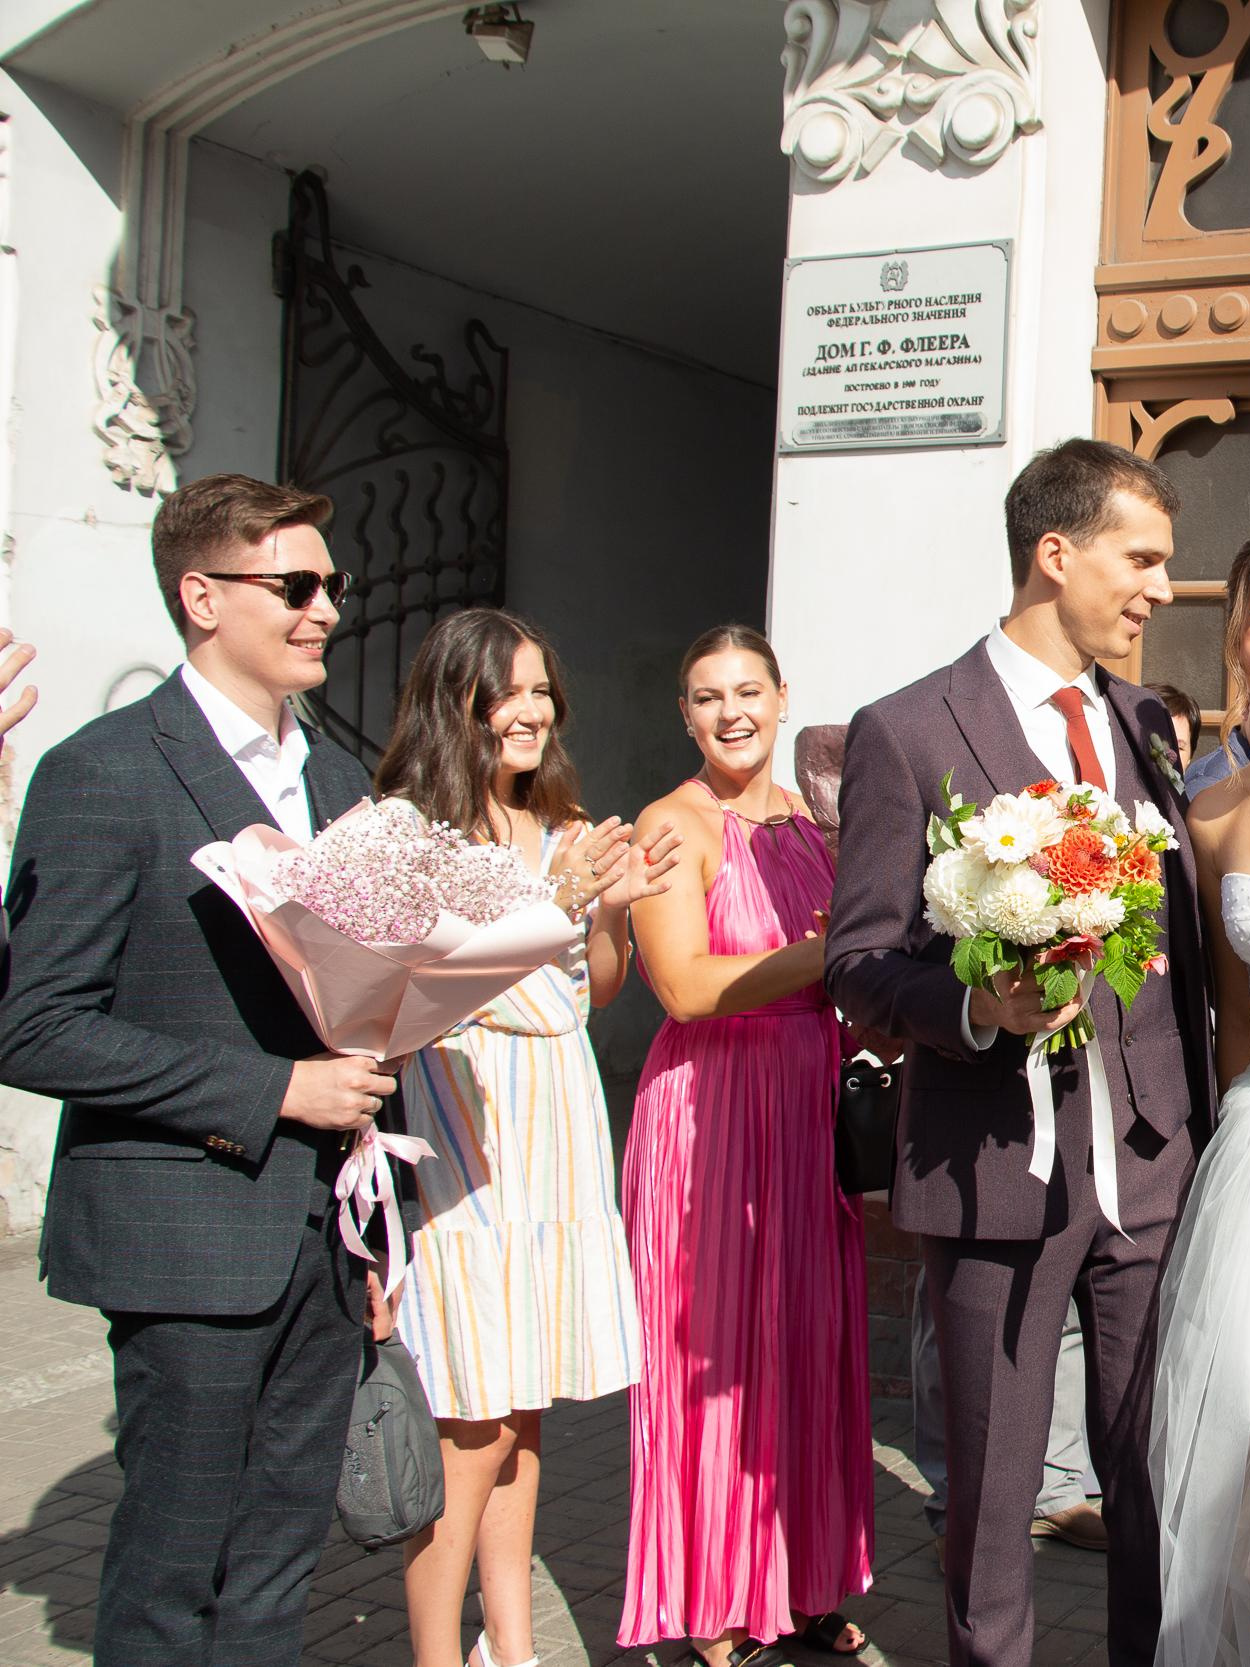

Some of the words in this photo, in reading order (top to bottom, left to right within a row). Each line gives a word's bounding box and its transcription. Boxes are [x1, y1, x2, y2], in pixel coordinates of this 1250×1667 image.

[807, 303, 847, 316] ОБЪЕКТ
[925, 293, 982, 307] НАСЛЕДИЯ
[827, 312, 909, 328] ФЕДЕРАЛЬНОГО
[911, 308, 966, 321] ЗНАЧЕНИЯ
[815, 342, 856, 363] ДОМ
[860, 341, 872, 357] Г.
[877, 339, 895, 355] Ф.
[900, 333, 970, 353] ФЛЕЕРА
[844, 381, 890, 392] ПОСТРОЕНО
[920, 379, 941, 388] ГОДУ
[798, 403, 849, 416] ПОДЛЕЖИТ
[851, 396, 945, 412] ГОСУДАРСТВЕННОЙ
